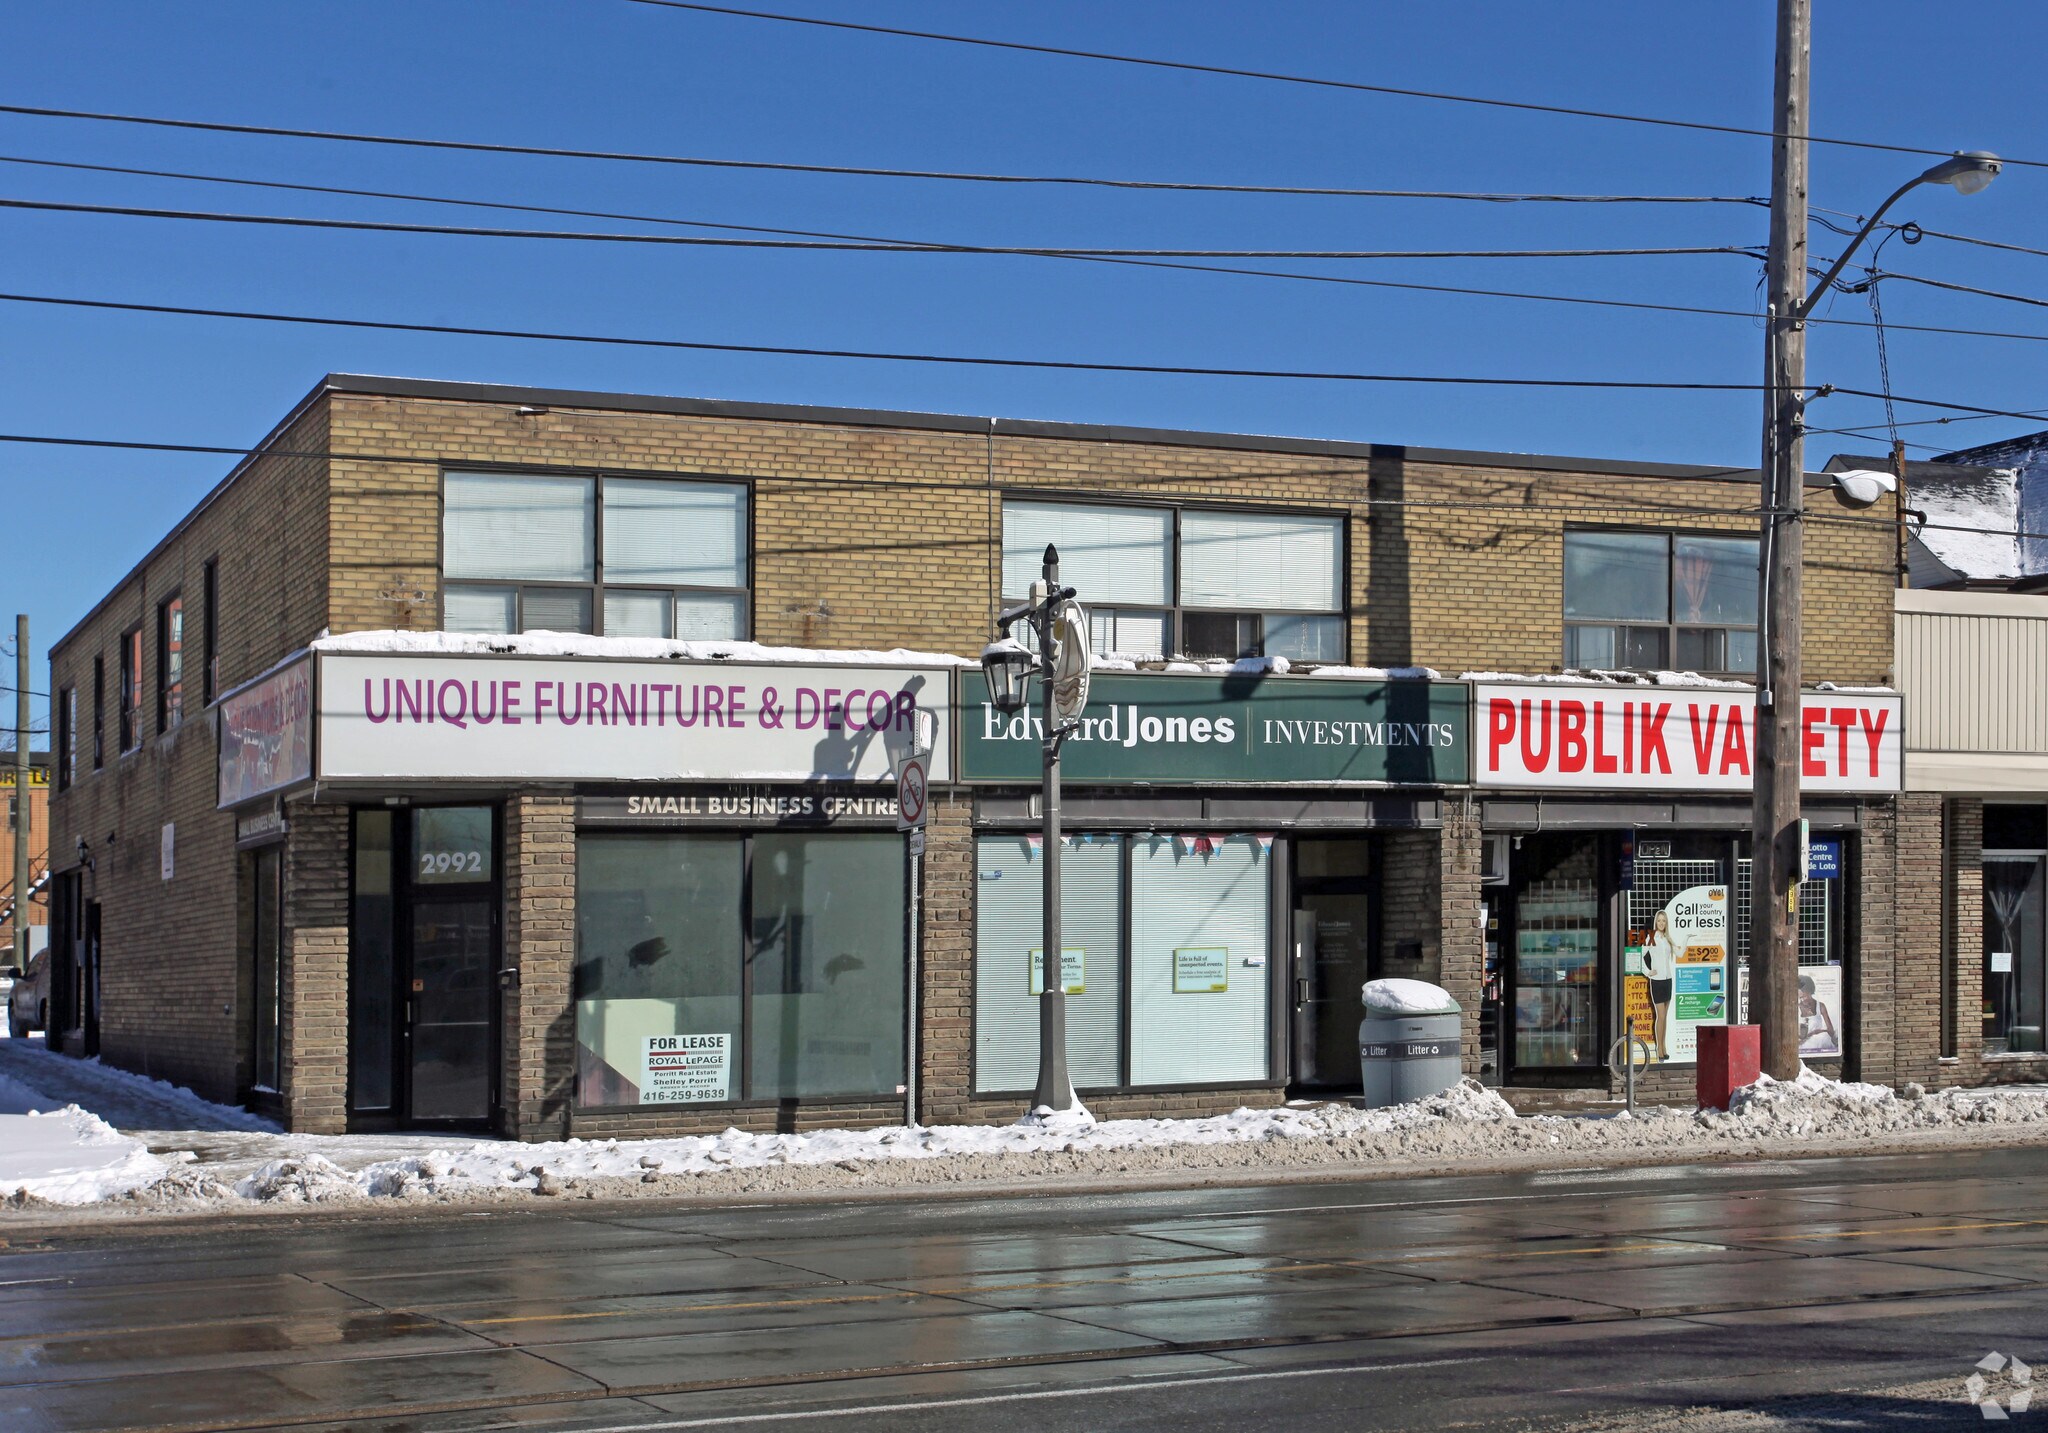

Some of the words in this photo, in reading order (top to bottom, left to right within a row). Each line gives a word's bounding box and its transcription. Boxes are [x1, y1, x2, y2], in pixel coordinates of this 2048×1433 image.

[364, 677, 522, 730] UNIQUE
[534, 680, 746, 730] FURNITURE
[758, 686, 786, 730] &
[795, 687, 916, 732] DECOR
[1123, 704, 1236, 748] Jones
[1263, 719, 1454, 748] INVESTMENTS
[1489, 698, 1673, 775] PUBLIK
[1688, 703, 1889, 778] VAETY
[627, 796, 701, 814] SMALL
[708, 797, 813, 815] BUSINESS
[821, 797, 898, 815] CENTRE
[1642, 844, 1668, 855] OPEN
[1808, 844, 1828, 852] Lotto
[421, 851, 481, 874] 2992
[1808, 853, 1833, 861] Centre
[1675, 903, 1698, 916] Call
[1675, 916, 1692, 928] for
[1696, 916, 1725, 928] less!
[1628, 930, 1657, 946] FAX
[1631, 992, 1643, 1000] TTC
[1679, 996, 1685, 1005] 2
[650, 1038, 677, 1049] FOR
[683, 1037, 724, 1048] LEASE
[1370, 1045, 1388, 1056] Litter
[1407, 1044, 1430, 1055] Litter
[649, 1057, 683, 1066] ROYAL
[643, 1089, 725, 1101] 416-259-9639
